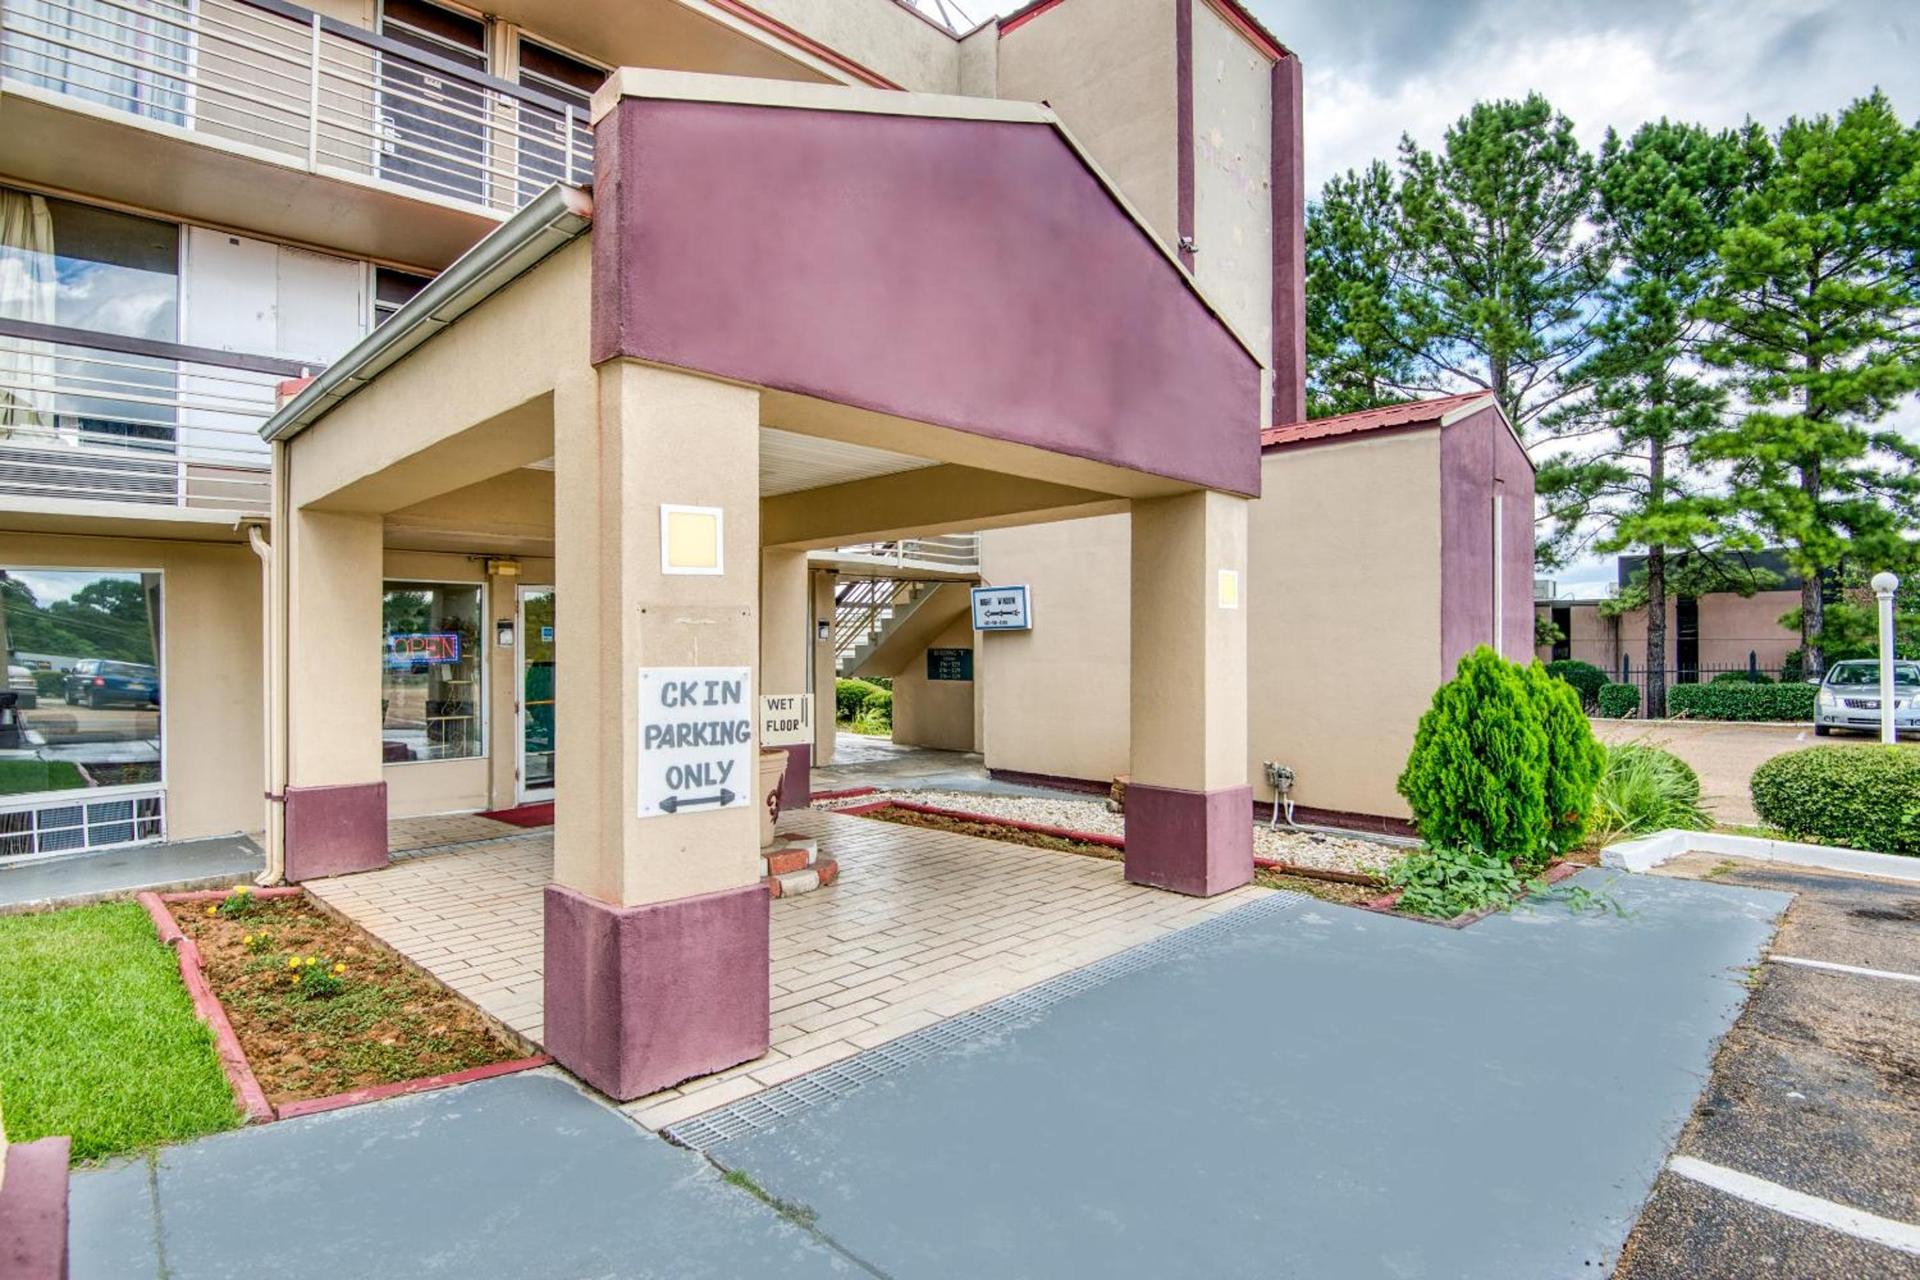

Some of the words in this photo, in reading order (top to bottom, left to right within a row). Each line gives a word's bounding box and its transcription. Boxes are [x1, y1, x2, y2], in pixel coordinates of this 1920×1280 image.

[393, 636, 455, 659] OPEN
[767, 698, 794, 711] WET
[644, 720, 751, 750] PARKING
[766, 720, 800, 732] FLOOR
[665, 760, 735, 790] ONLY
